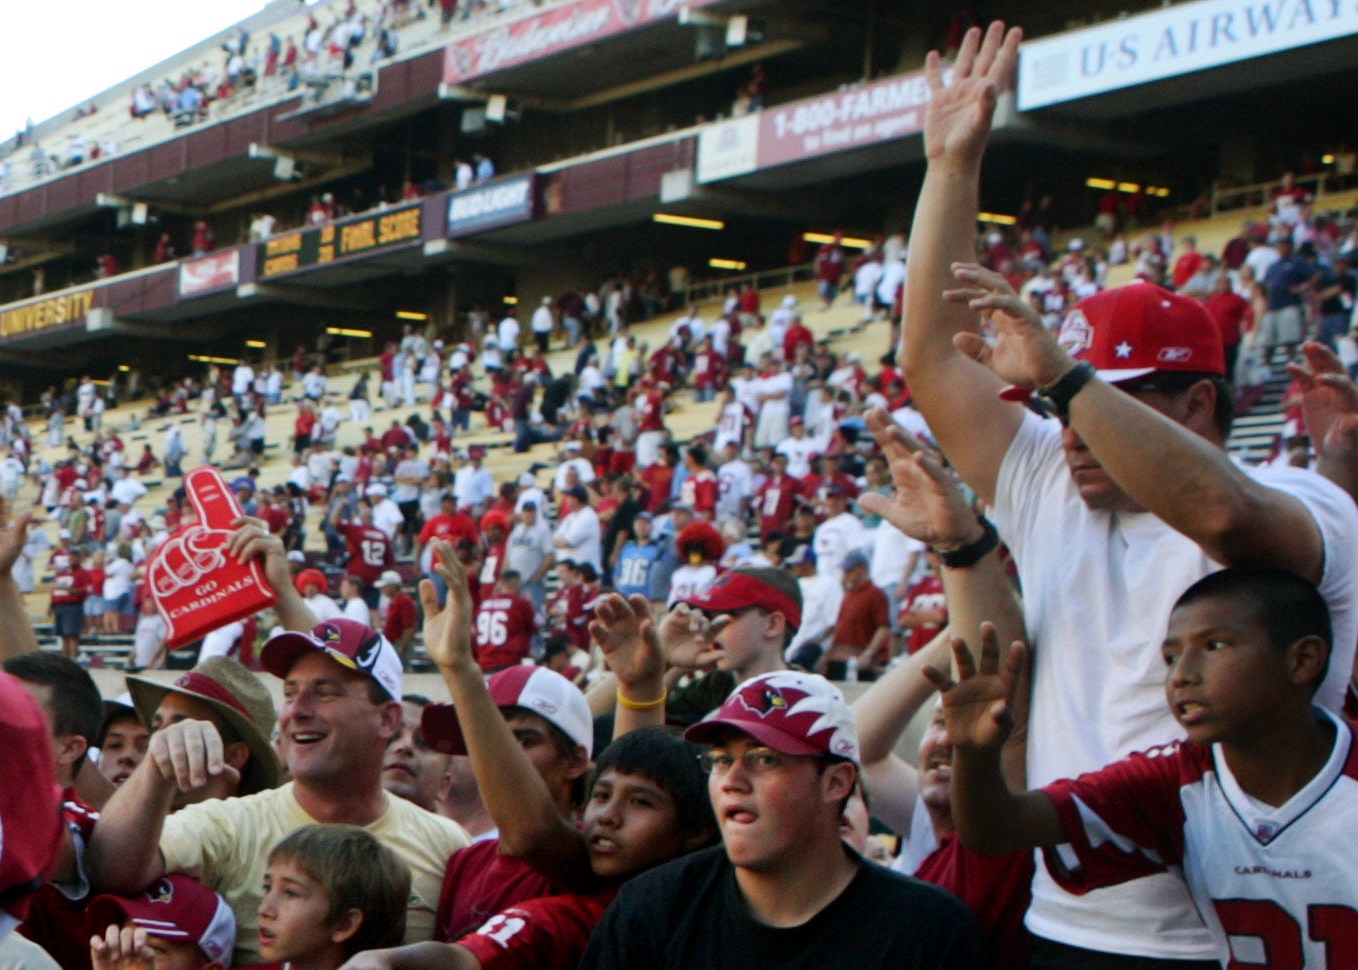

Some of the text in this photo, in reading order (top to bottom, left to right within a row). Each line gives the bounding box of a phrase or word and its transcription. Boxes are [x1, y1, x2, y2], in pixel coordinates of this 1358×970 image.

[1153, 0, 1358, 62] AIRWAY
[168, 575, 255, 619] CARDINALS
[194, 579, 219, 596] GO
[476, 610, 509, 646] 96
